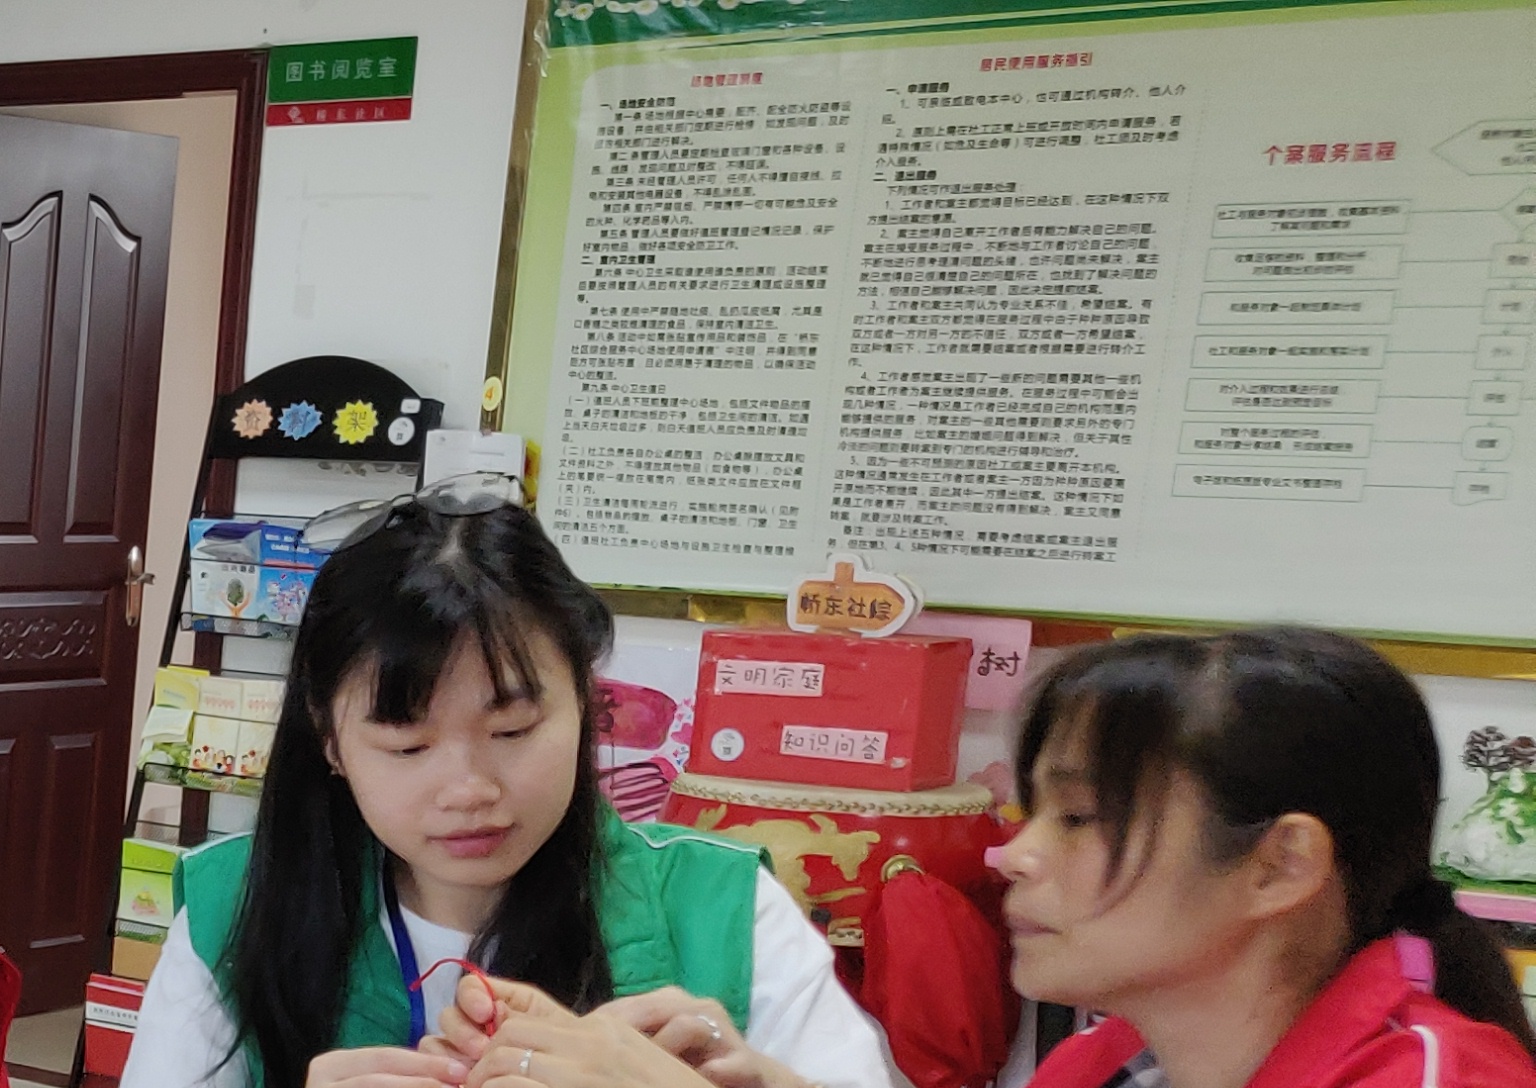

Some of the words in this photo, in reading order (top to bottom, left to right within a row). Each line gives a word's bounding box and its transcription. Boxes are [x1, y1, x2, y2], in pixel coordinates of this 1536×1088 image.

[286, 57, 398, 83] 图书阅览室
[1263, 141, 1397, 166] 个案服务流程
[717, 664, 821, 692] 文明家庭
[784, 729, 881, 761] 知识问答
